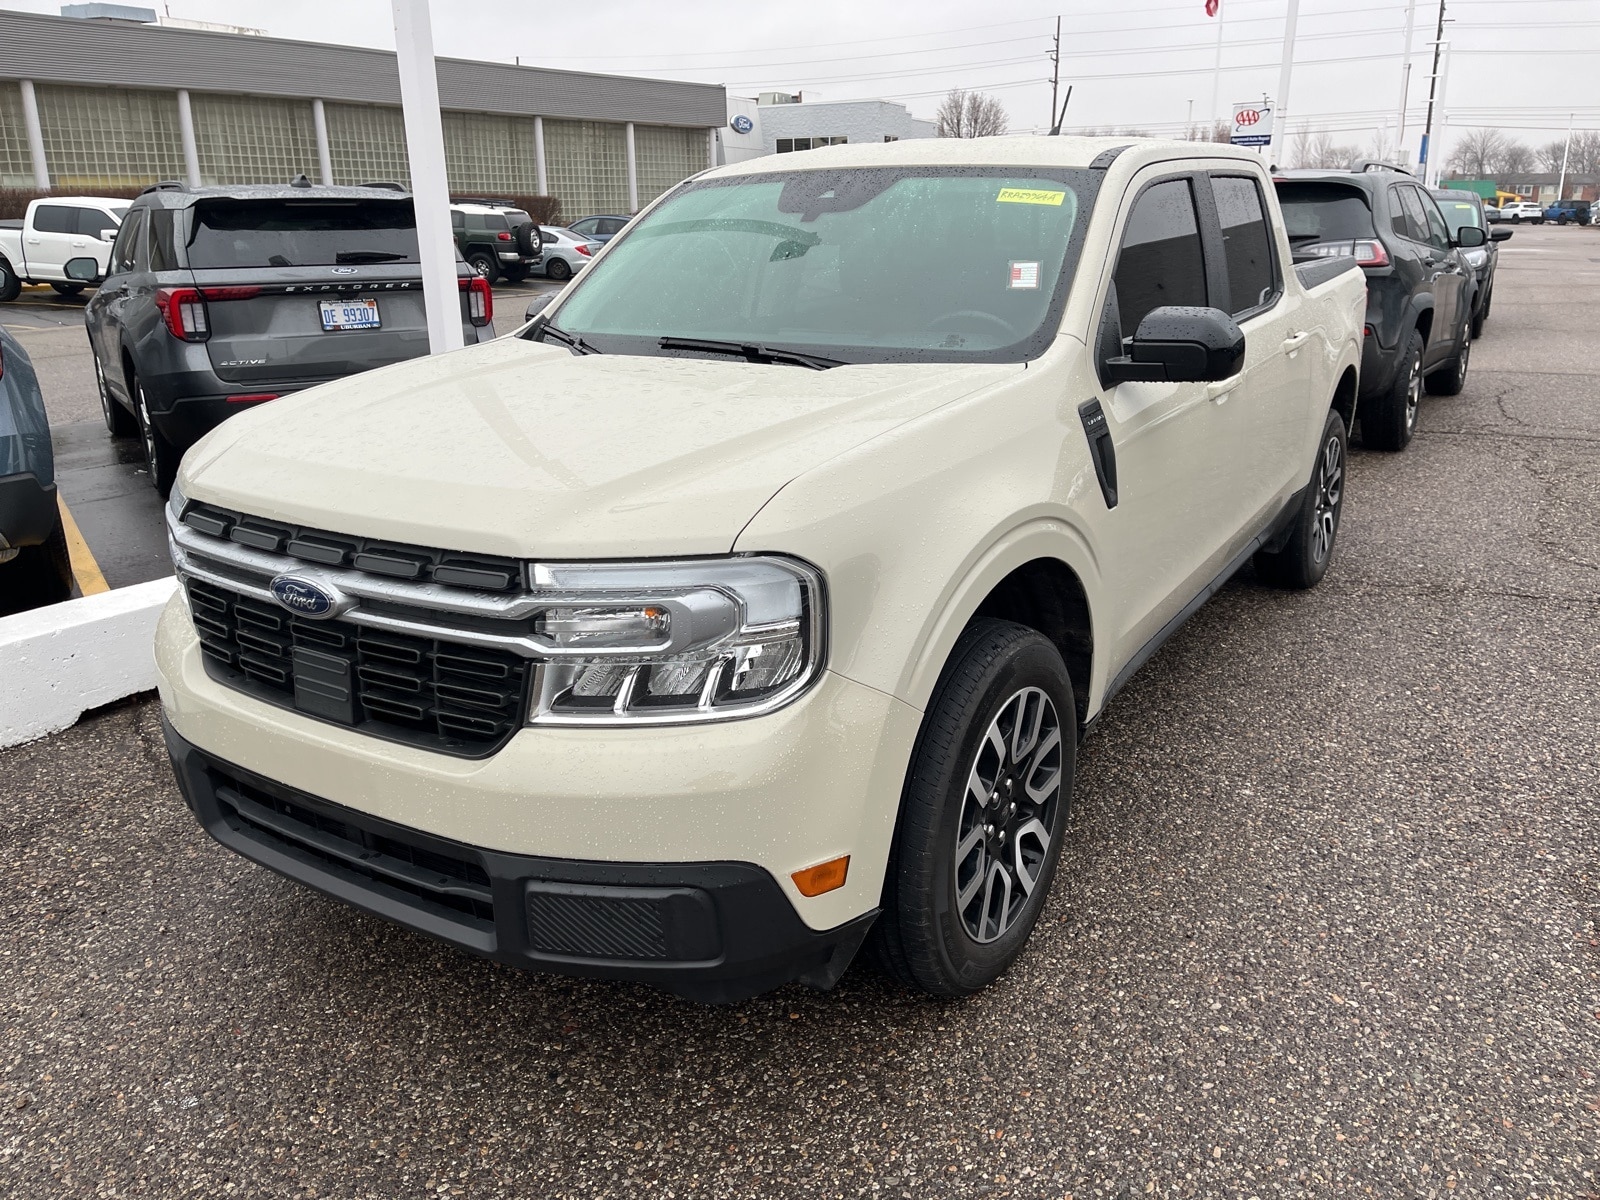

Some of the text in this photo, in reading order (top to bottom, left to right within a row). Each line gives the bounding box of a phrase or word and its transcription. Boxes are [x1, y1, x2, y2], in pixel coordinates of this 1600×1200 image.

[1237, 110, 1258, 125] AAA
[285, 282, 409, 292] EXPLORER
[323, 307, 375, 323] DE 99307
[282, 584, 317, 610] Ford
